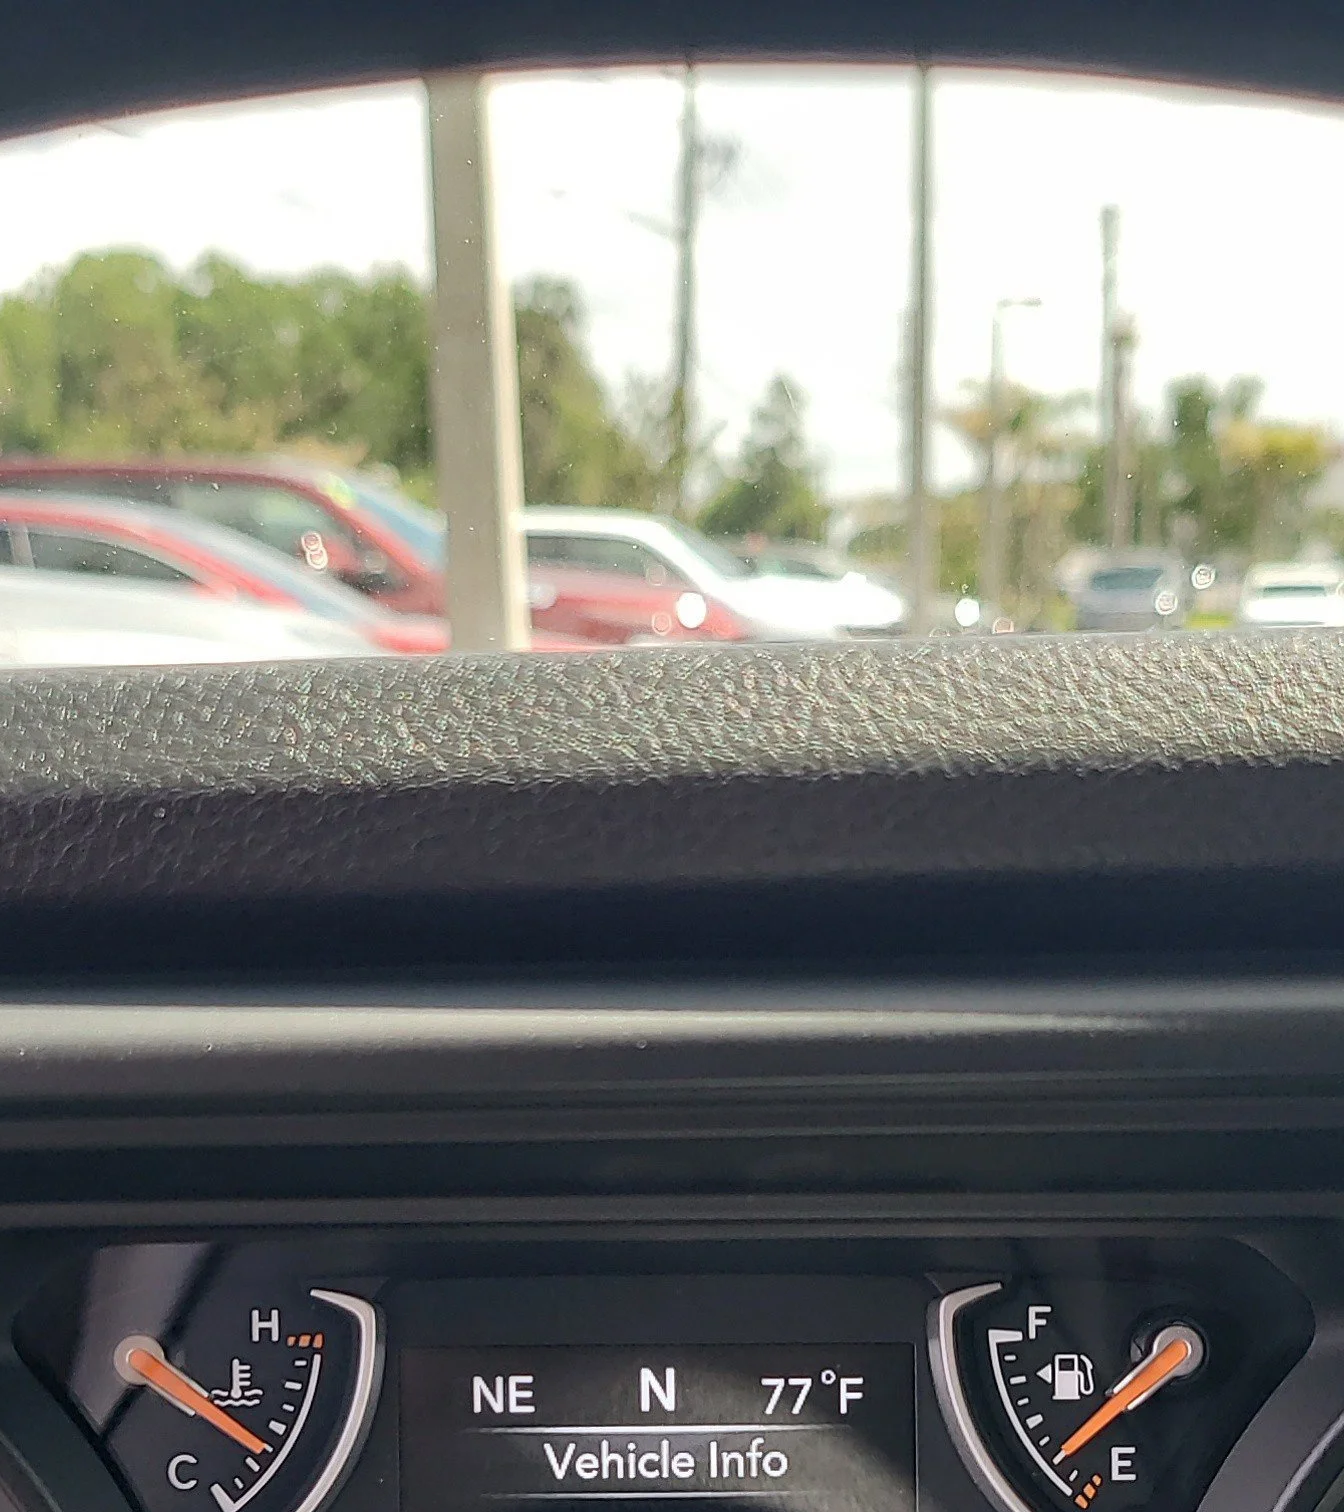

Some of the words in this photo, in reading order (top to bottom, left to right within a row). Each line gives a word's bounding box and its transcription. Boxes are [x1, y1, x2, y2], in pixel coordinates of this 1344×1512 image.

[251, 1309, 279, 1342] H
[1028, 1305, 1052, 1340] F
[471, 1376, 536, 1414] NE
[640, 1368, 677, 1412] N
[761, 1369, 864, 1414] 77°F
[167, 1454, 197, 1490] C
[544, 1440, 695, 1480] Vehicle
[709, 1437, 789, 1478] Info
[1111, 1446, 1136, 1481] E
